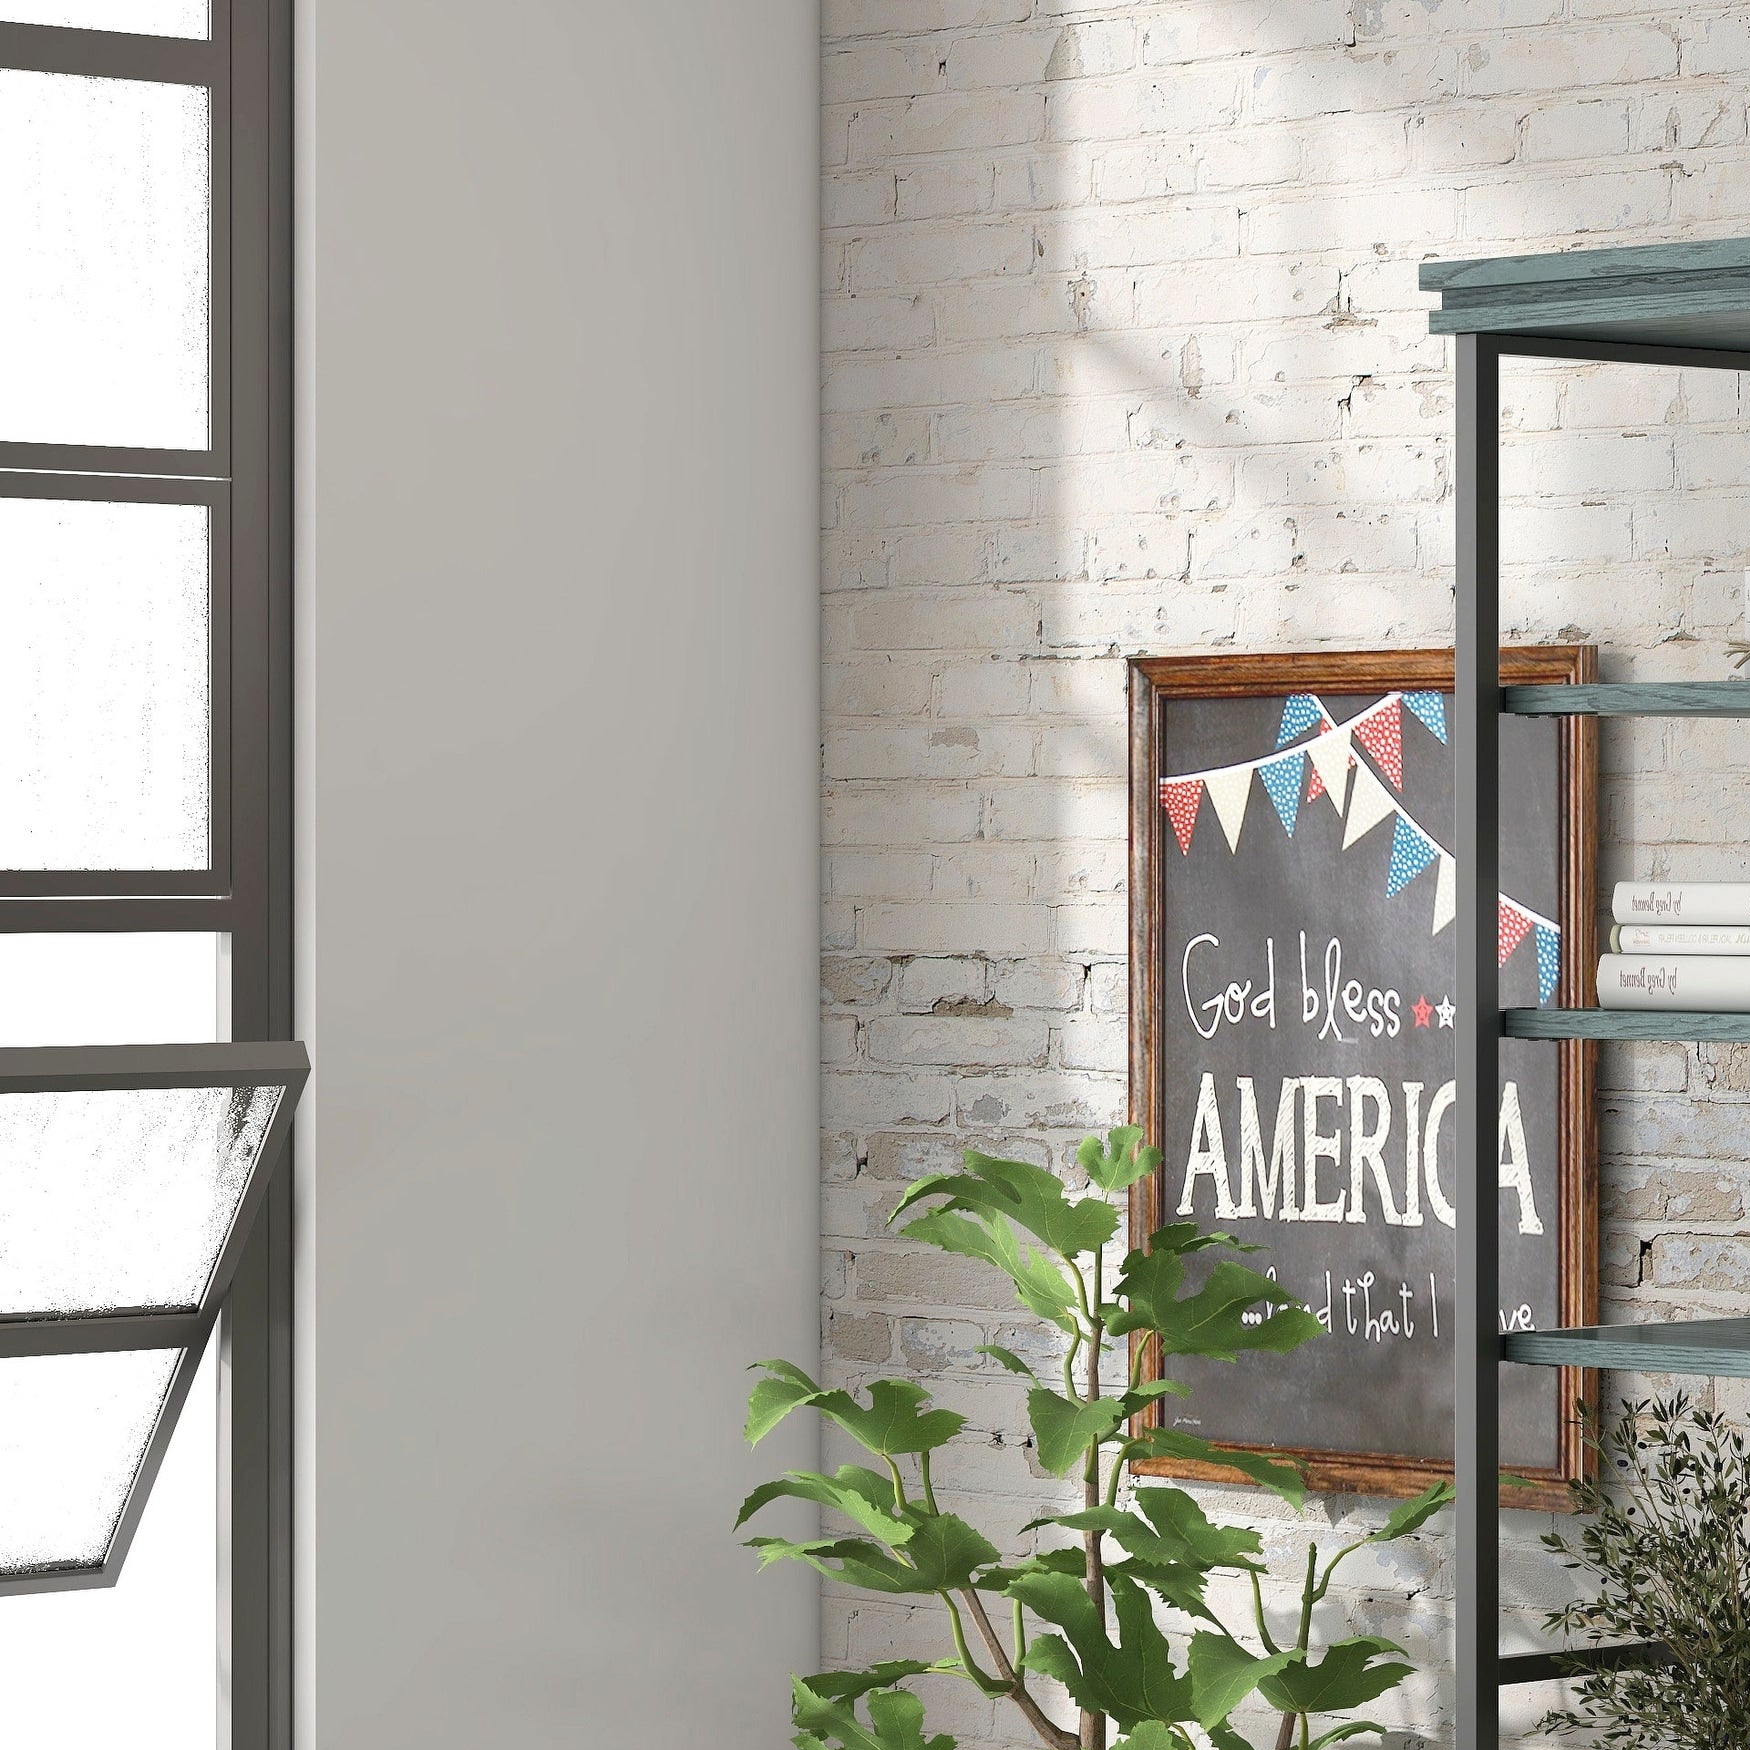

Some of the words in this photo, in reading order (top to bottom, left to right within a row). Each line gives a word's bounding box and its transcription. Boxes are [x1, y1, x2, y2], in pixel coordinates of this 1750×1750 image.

[1182, 933, 1275, 1040] God
[1300, 929, 1401, 1041] bless
[1341, 1270, 1415, 1343] that
[1429, 1272, 1440, 1338] I
